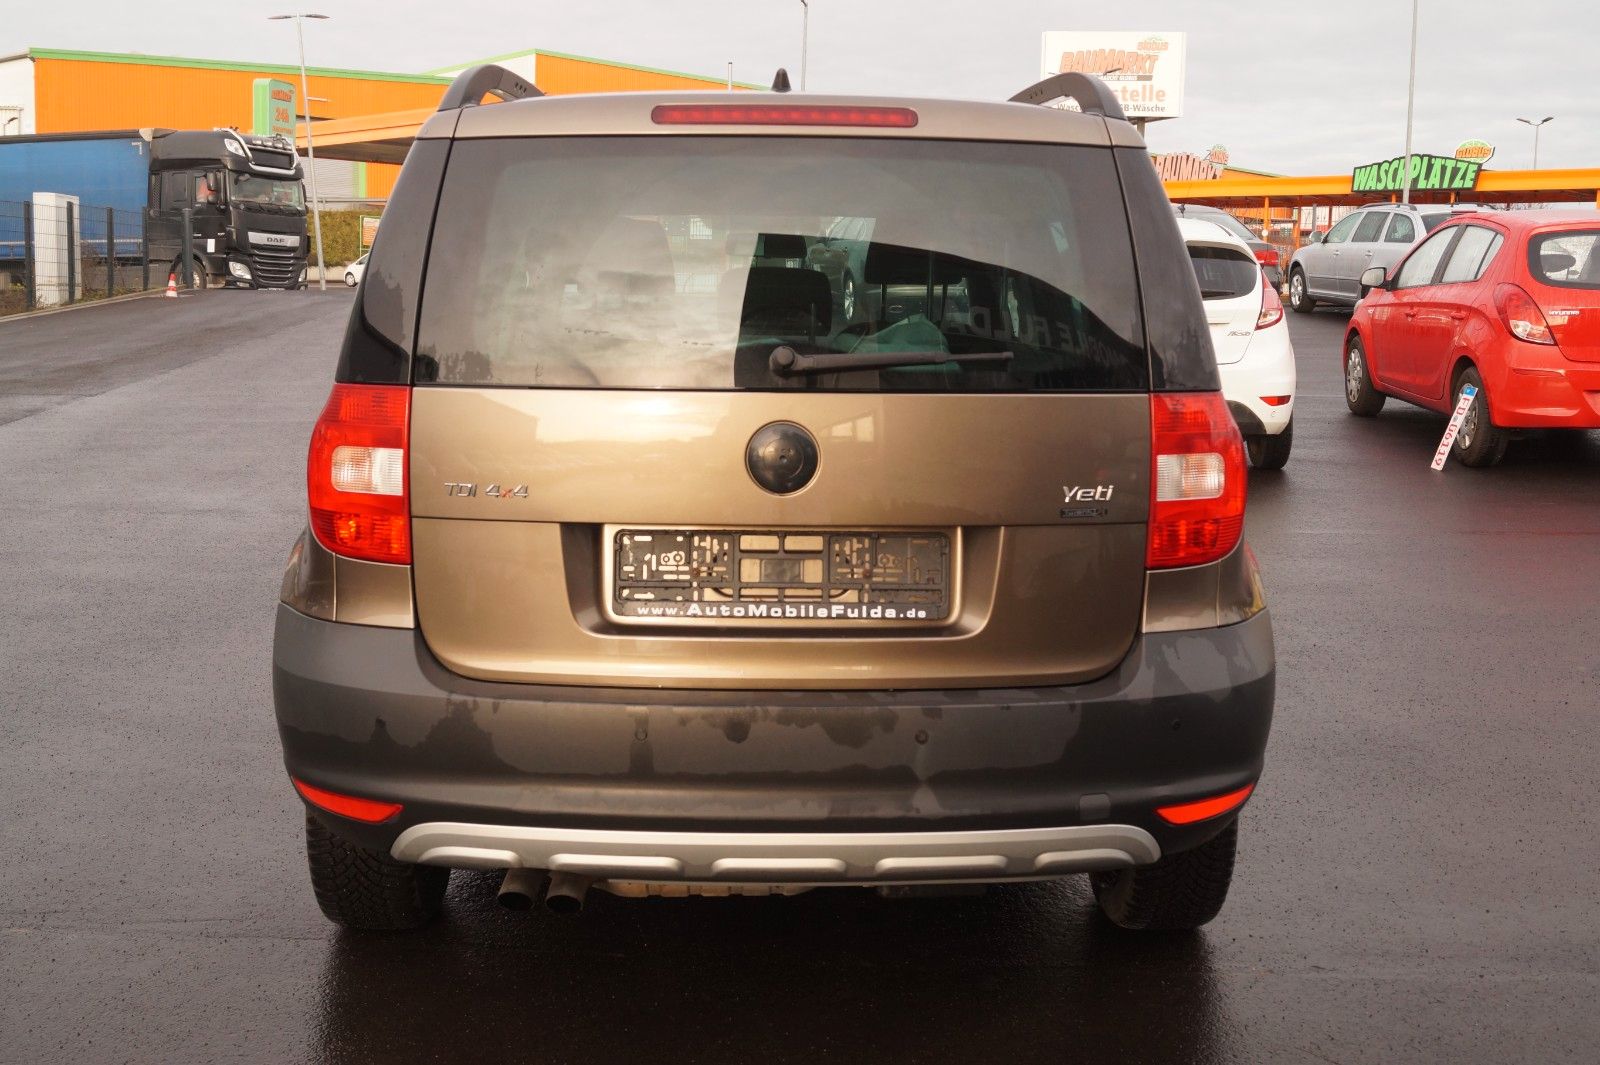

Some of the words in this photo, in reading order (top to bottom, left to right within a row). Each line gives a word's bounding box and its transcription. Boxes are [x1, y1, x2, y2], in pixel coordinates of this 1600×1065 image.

[1058, 49, 1159, 74] BAUMARKT
[266, 236, 286, 244] DAF
[444, 482, 477, 497] TDI
[486, 483, 528, 498] 4x4
[1063, 484, 1114, 503] Yeti
[637, 603, 927, 619] www.AutoMobileFulda.de
